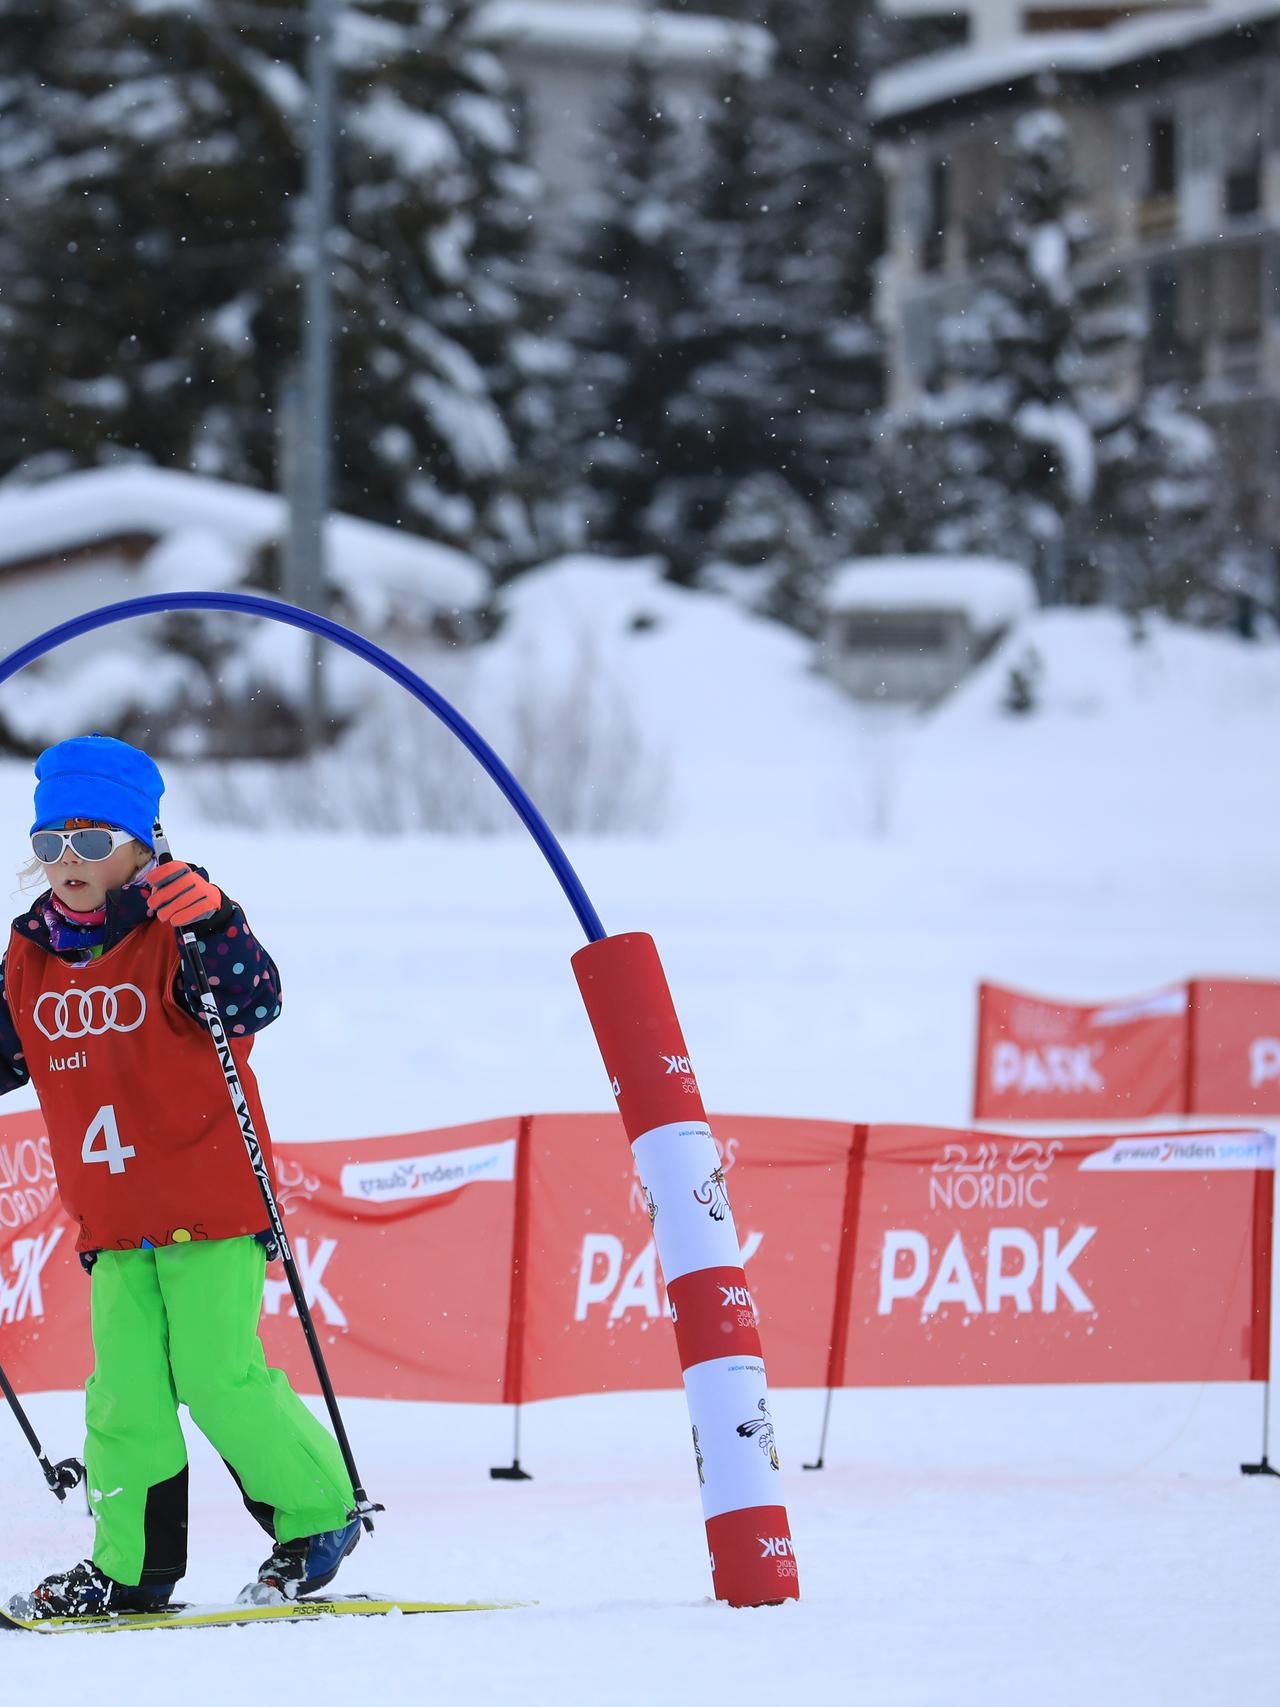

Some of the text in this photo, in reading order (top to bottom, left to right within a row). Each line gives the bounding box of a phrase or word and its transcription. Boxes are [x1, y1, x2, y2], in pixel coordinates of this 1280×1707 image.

[49, 1051, 87, 1072] Audi
[990, 1039, 1106, 1094] PARK
[81, 1104, 136, 1174] 4
[929, 1173, 1048, 1209] NORDIC
[877, 1226, 1097, 1315] PARK
[292, 1604, 329, 1615] FISCHER
